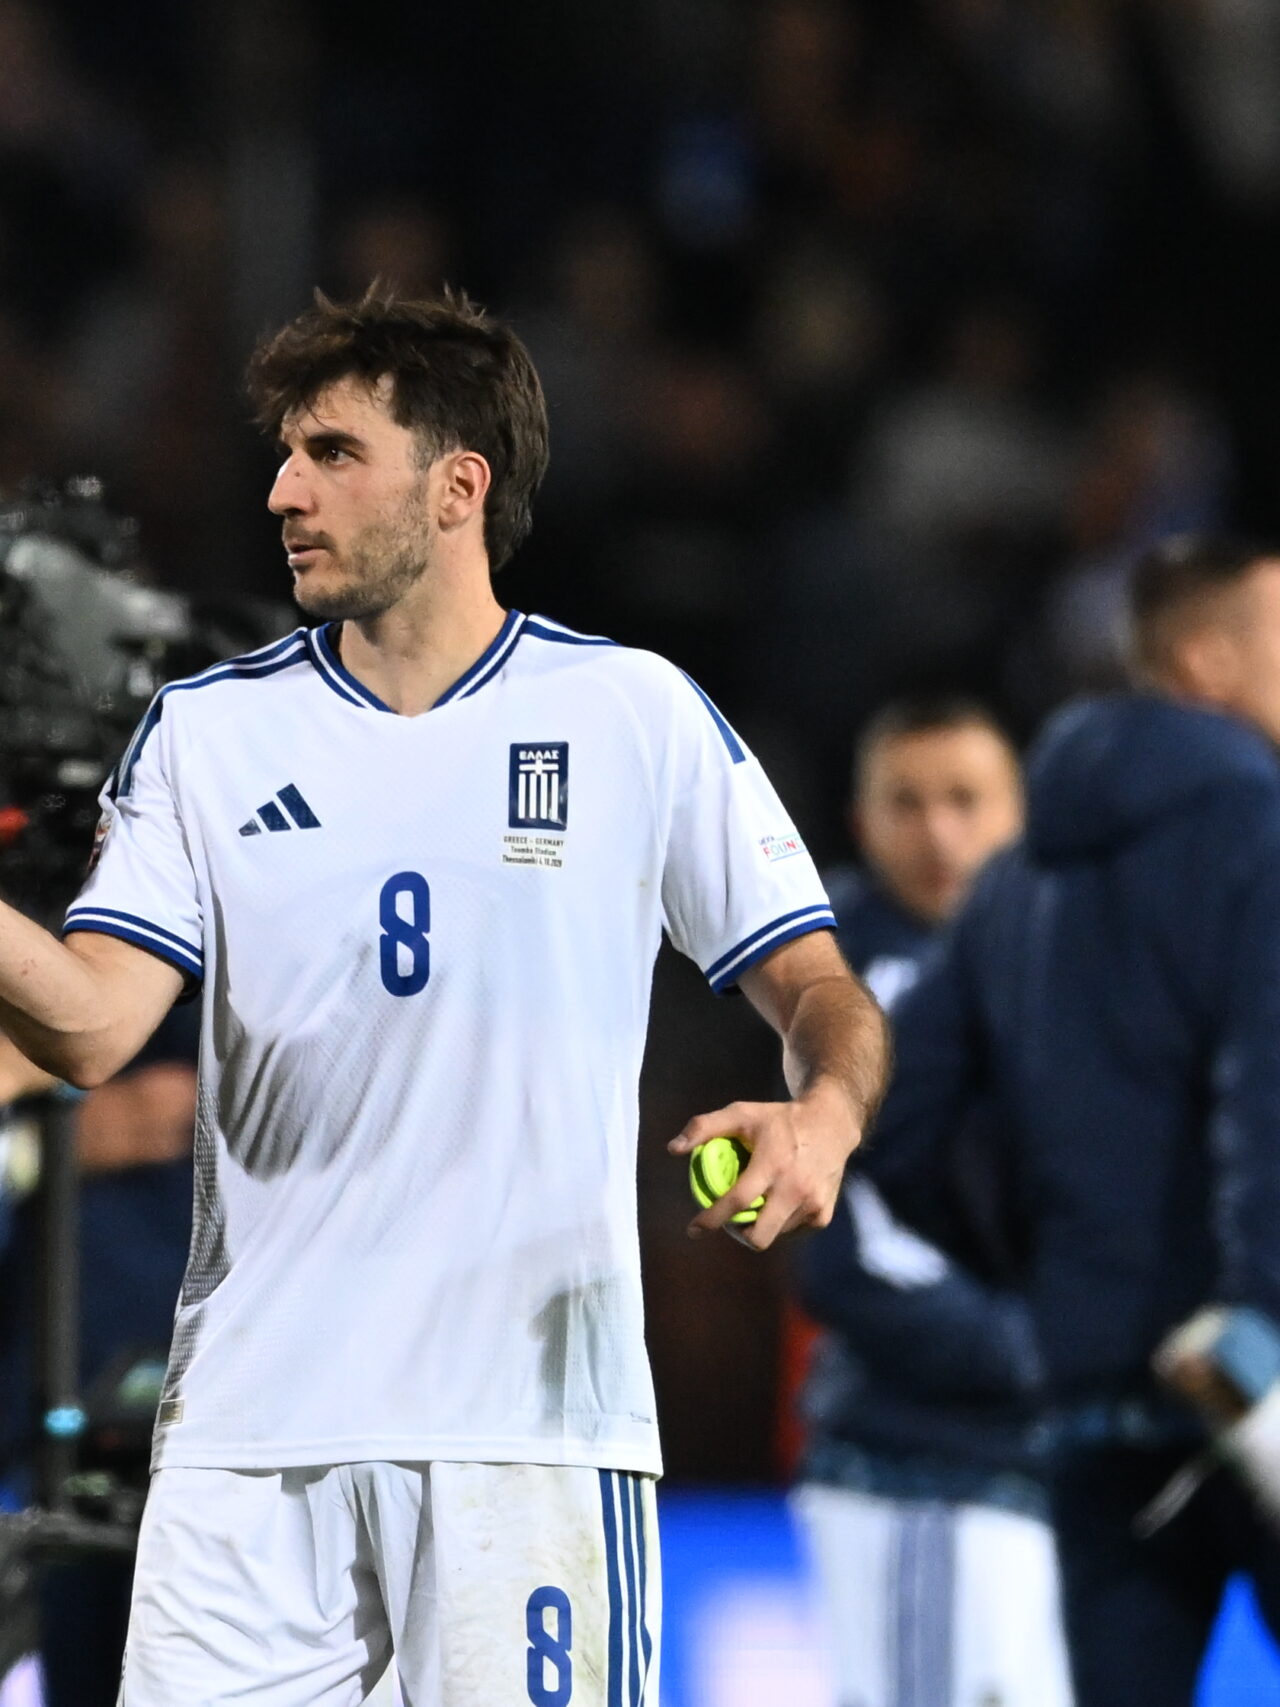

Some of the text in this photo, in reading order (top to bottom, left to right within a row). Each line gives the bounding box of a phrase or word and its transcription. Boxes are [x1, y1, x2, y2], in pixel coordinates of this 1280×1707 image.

[503, 836, 528, 844] GREECE
[535, 838, 564, 846] GERMANY
[379, 871, 431, 997] 8
[526, 1586, 572, 1707] 8
